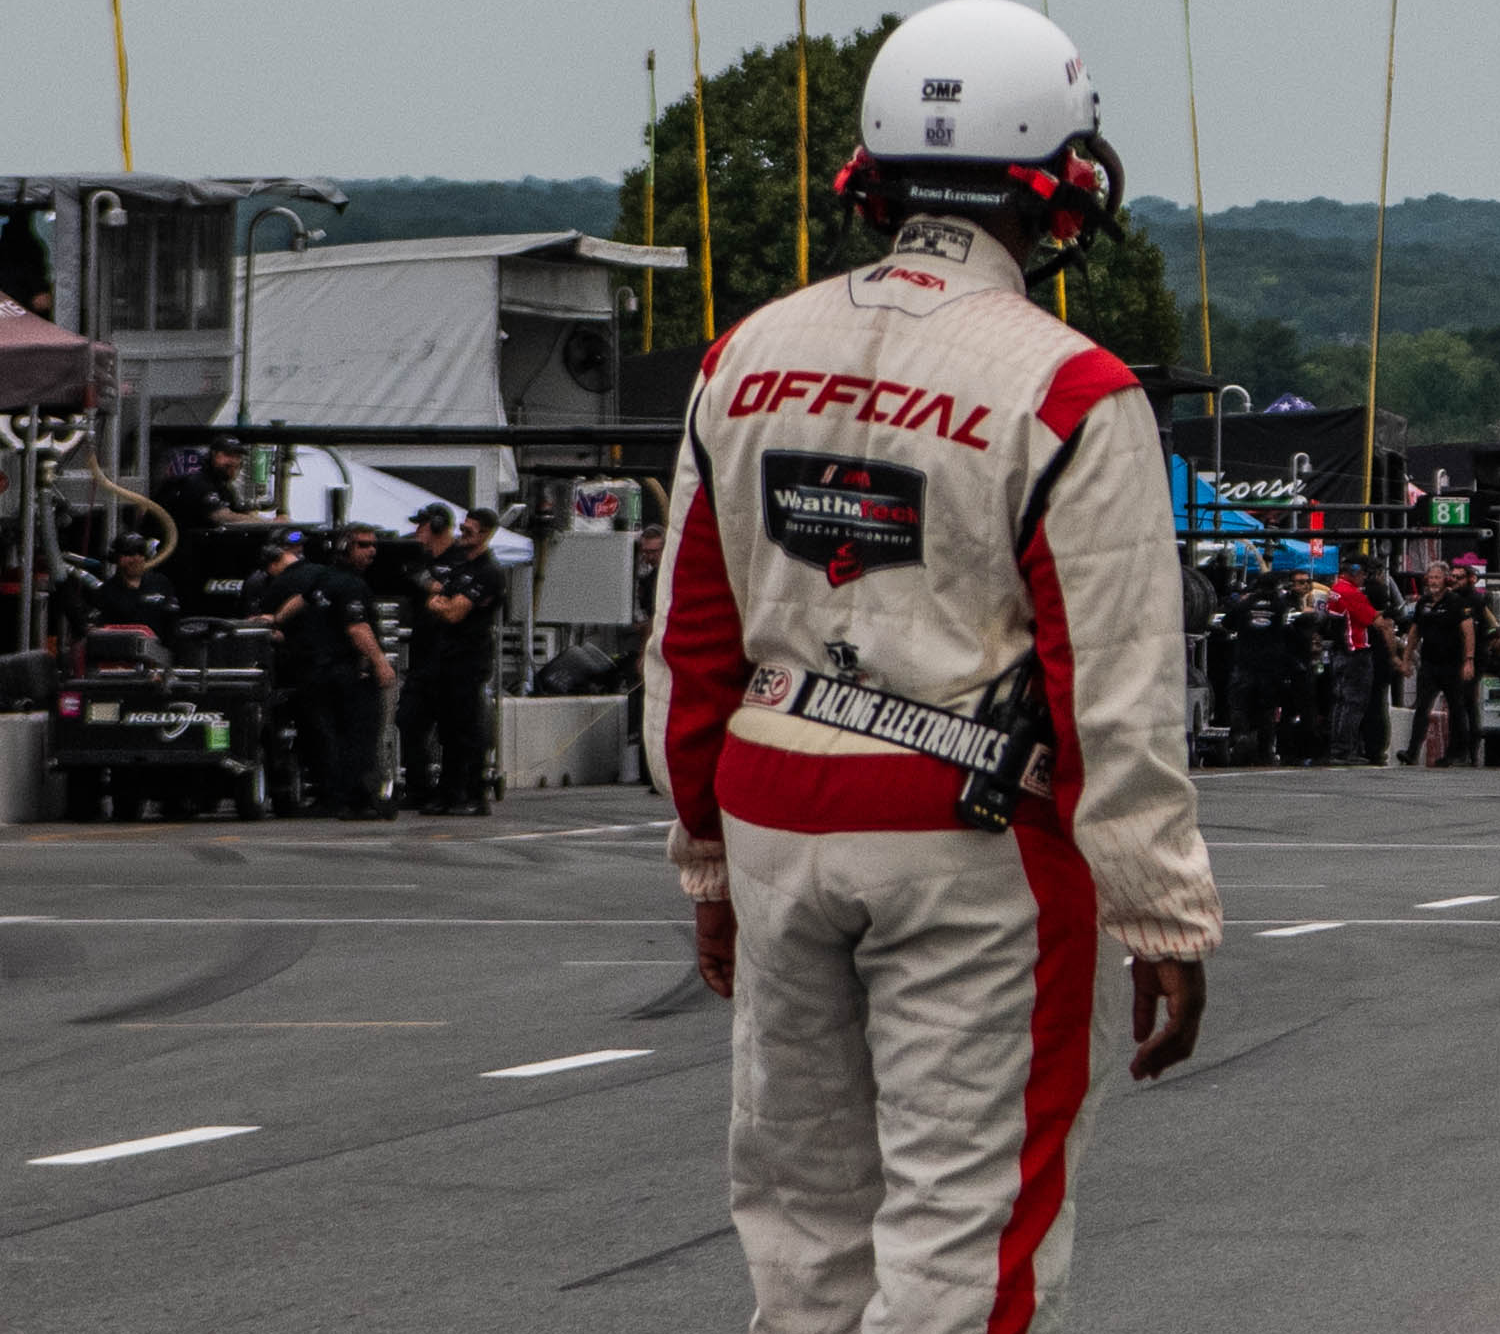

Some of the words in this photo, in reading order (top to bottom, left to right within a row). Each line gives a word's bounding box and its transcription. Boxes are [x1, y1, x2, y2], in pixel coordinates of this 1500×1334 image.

[922, 83, 962, 98] OMP
[727, 371, 991, 451] OFFCIAL
[1437, 505, 1467, 523] 81
[803, 678, 882, 731] RACING
[871, 697, 1009, 772] ELECTRONICS
